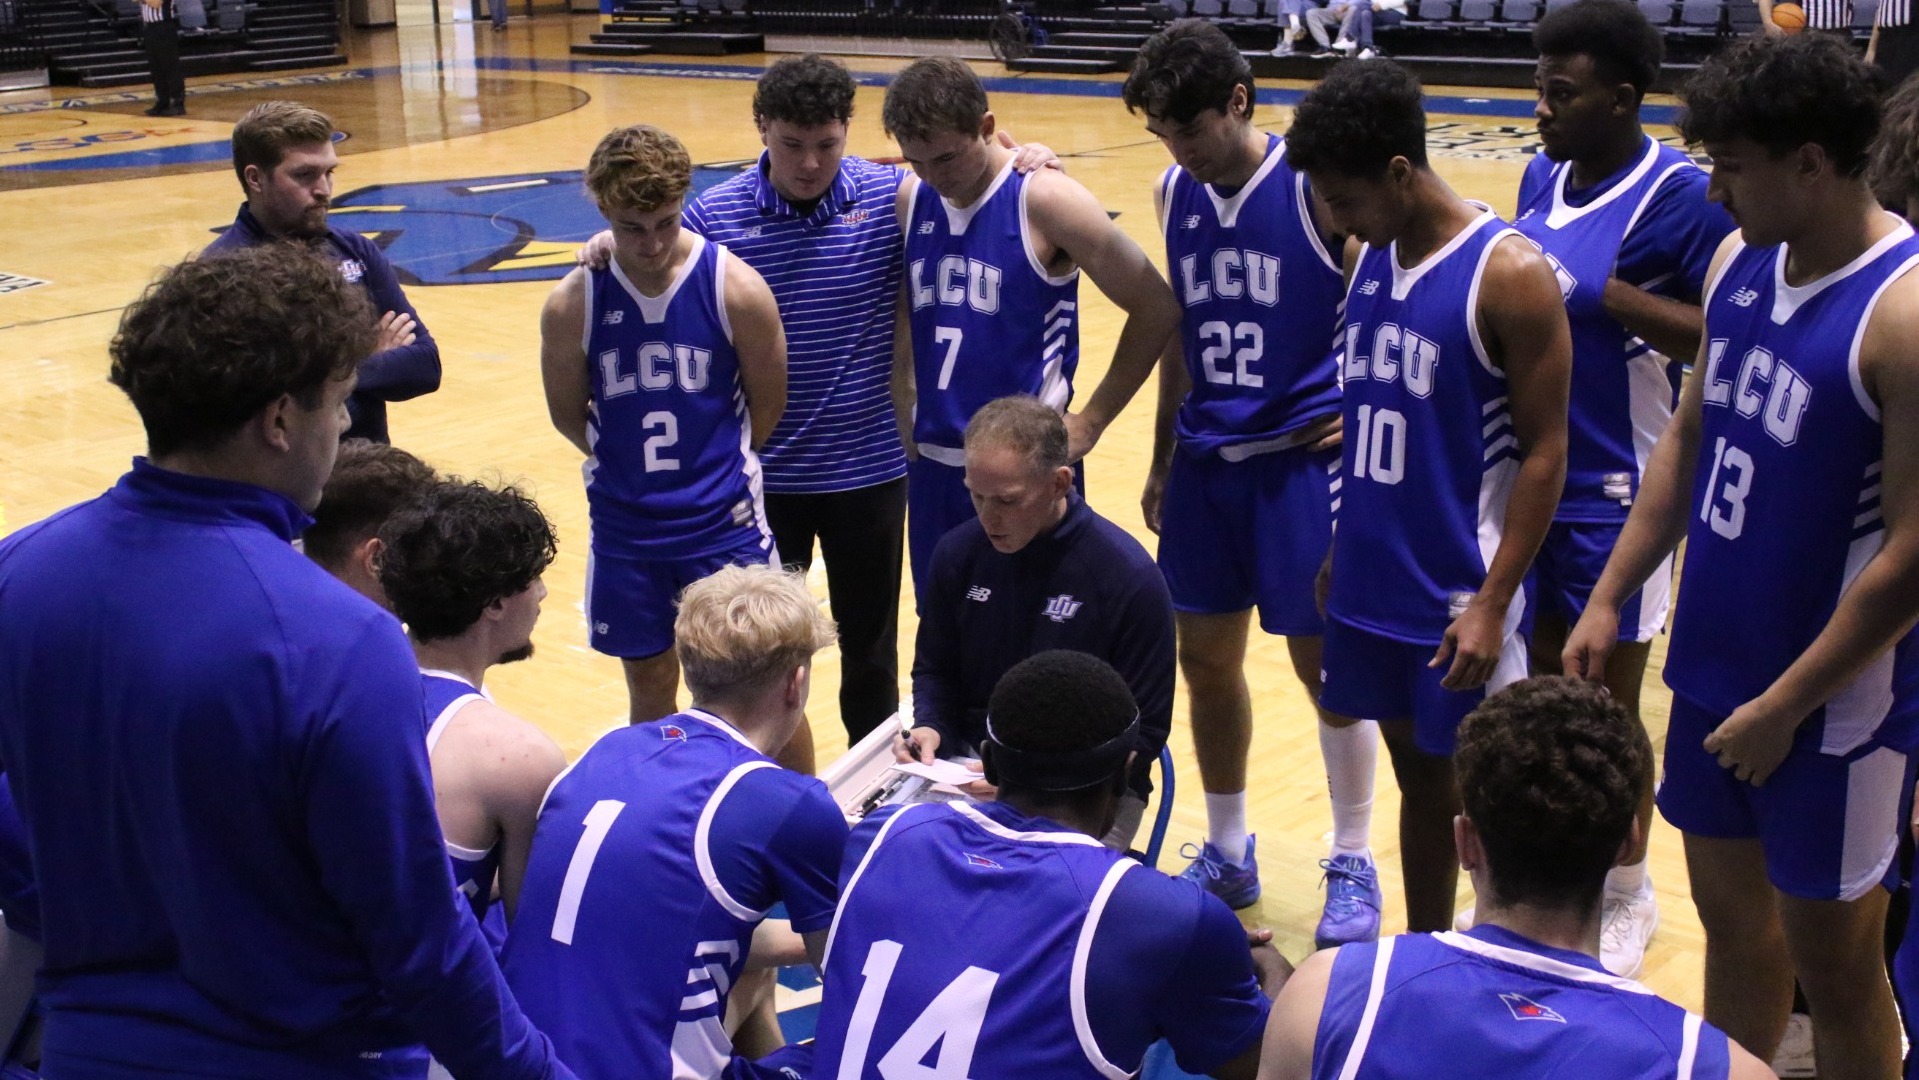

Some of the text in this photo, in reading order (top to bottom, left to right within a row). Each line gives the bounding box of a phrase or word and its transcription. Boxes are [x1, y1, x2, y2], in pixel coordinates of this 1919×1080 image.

[910, 254, 1002, 316] LCU
[1180, 248, 1280, 308] LCU
[599, 341, 712, 400] LCU
[935, 325, 963, 390] 7
[1199, 320, 1264, 388] 22
[1344, 321, 1440, 400] LCU
[1703, 338, 1813, 448] LCU
[642, 410, 680, 473] 2
[1353, 404, 1407, 485] 10
[1700, 436, 1755, 541] 13
[551, 799, 627, 946] 1
[837, 939, 1000, 1080] 14
